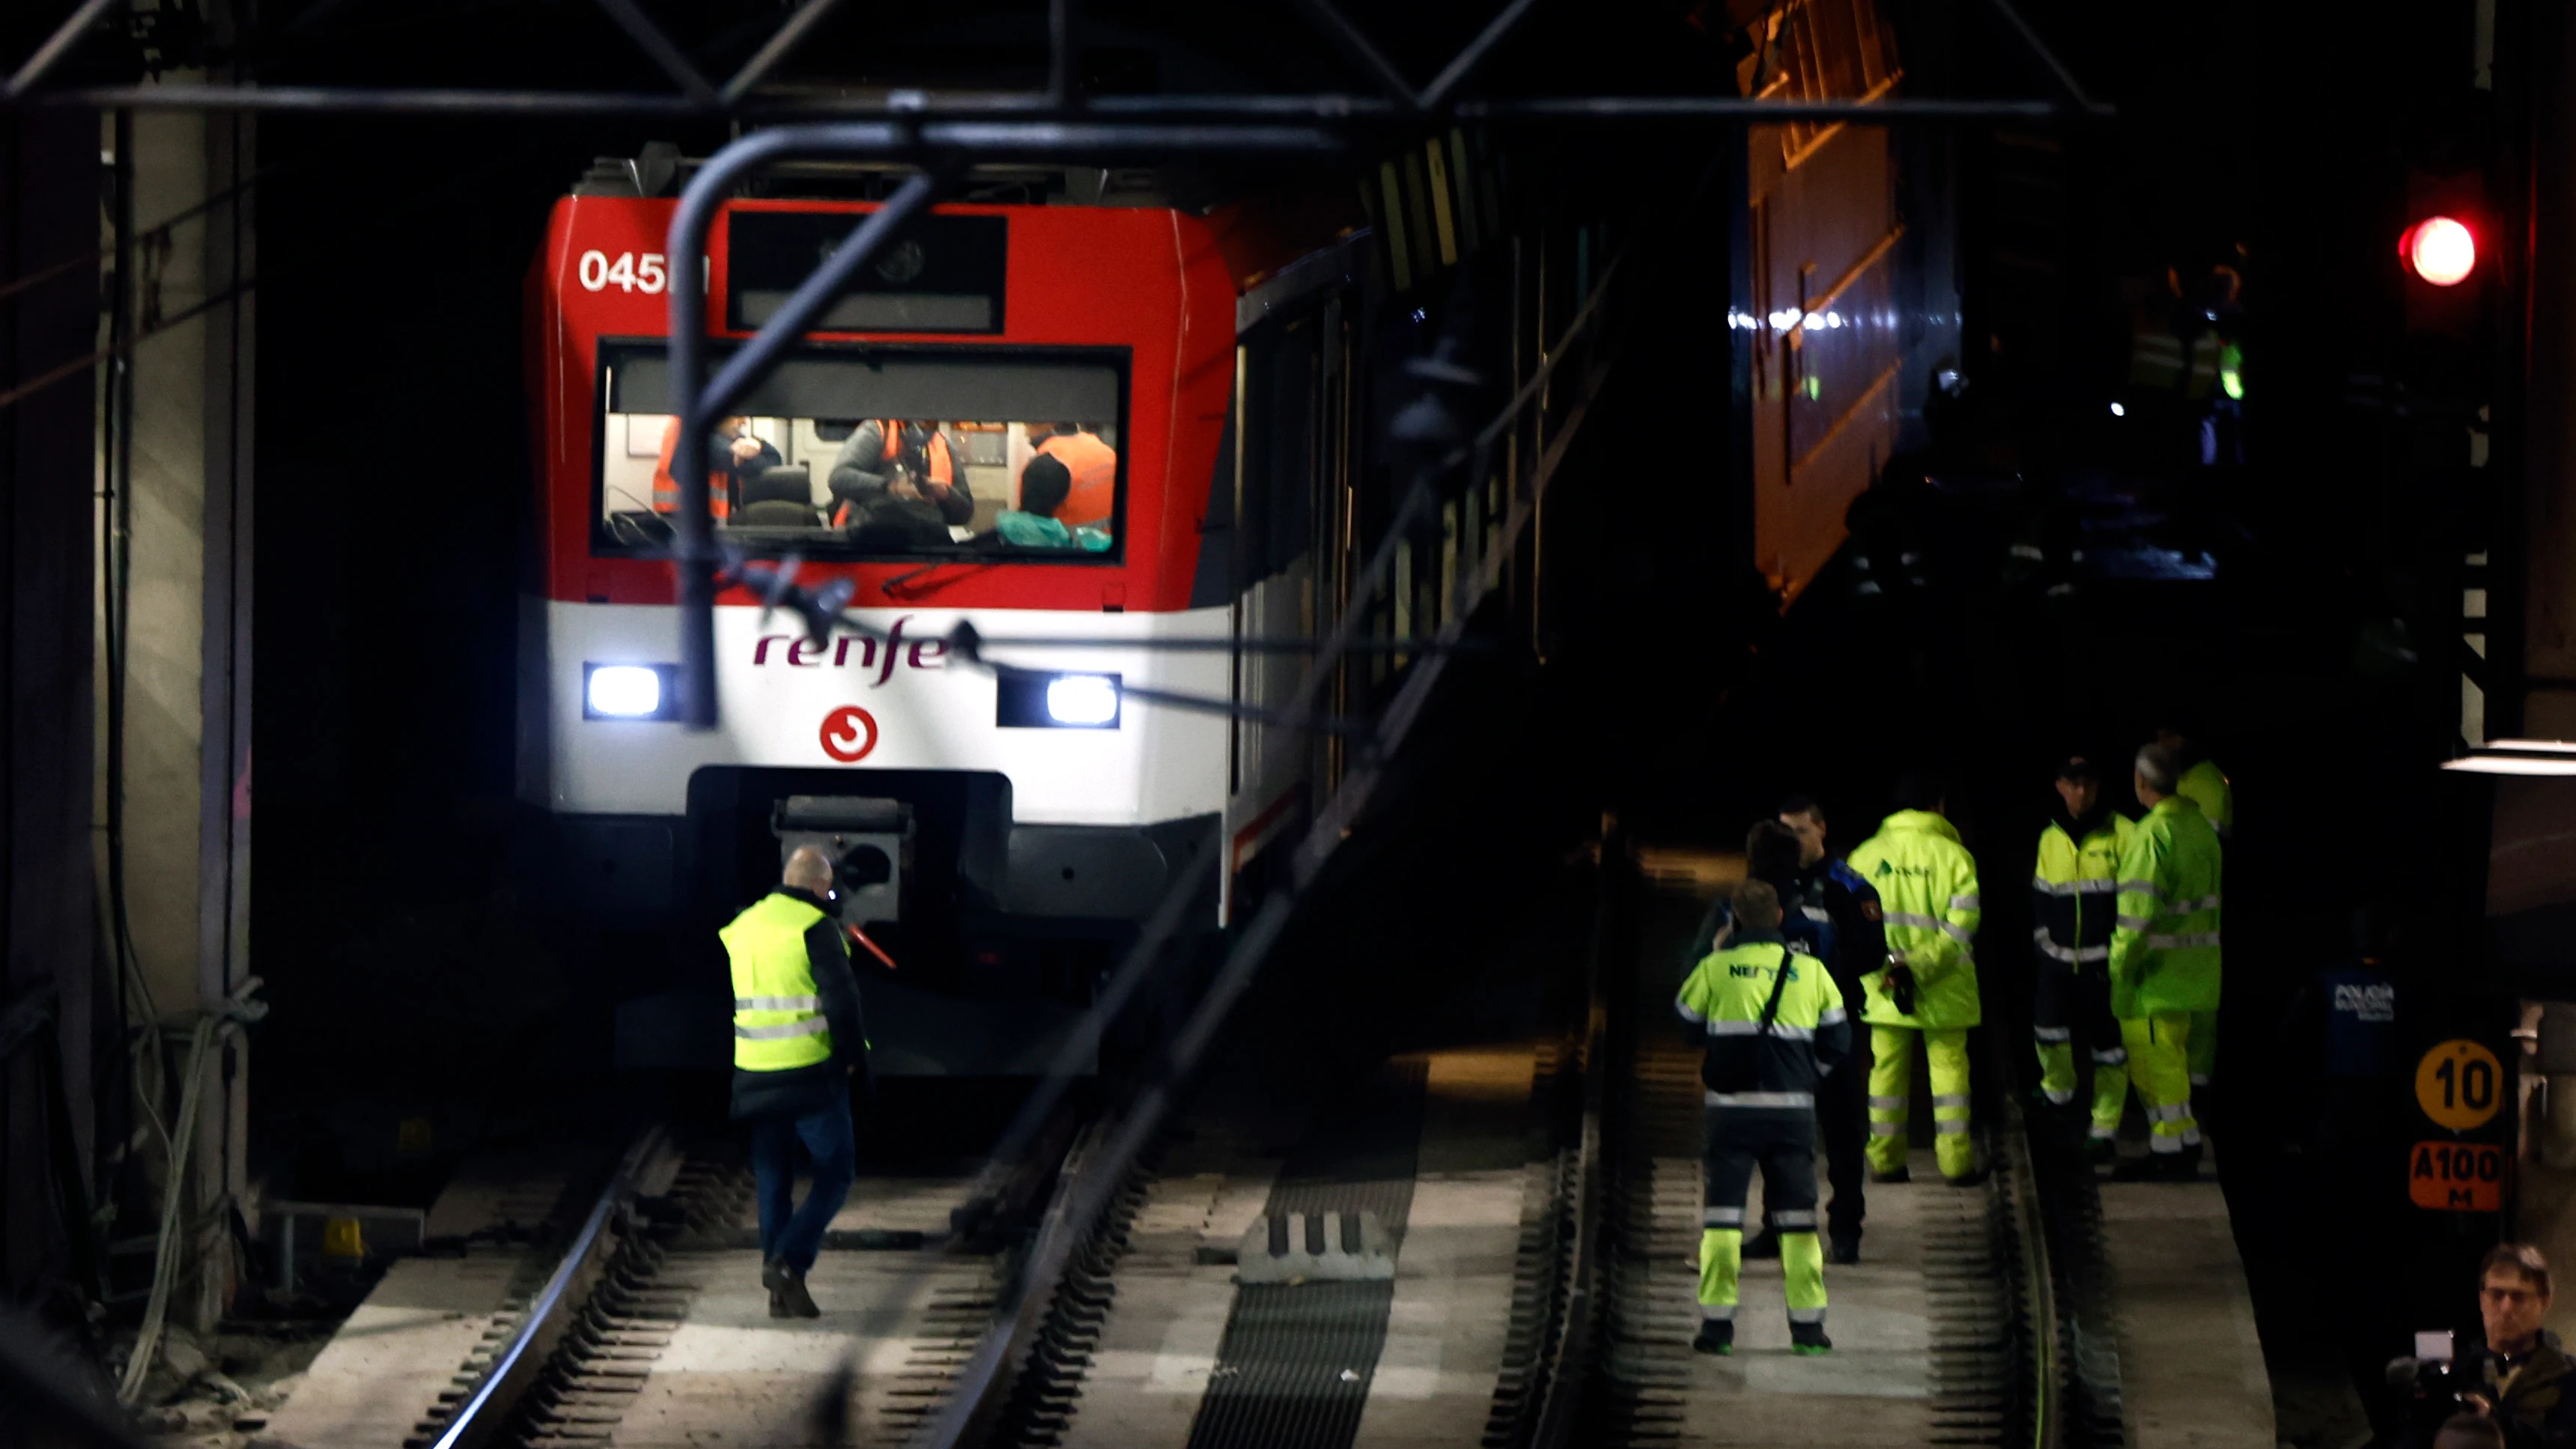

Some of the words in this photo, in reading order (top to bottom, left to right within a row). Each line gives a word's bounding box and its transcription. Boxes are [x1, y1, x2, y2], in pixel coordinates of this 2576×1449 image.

[754, 615, 945, 688] renfe
[2436, 1058, 2493, 1110] 10
[2415, 1146, 2499, 1182] A100
[2449, 1188, 2473, 1206] M
